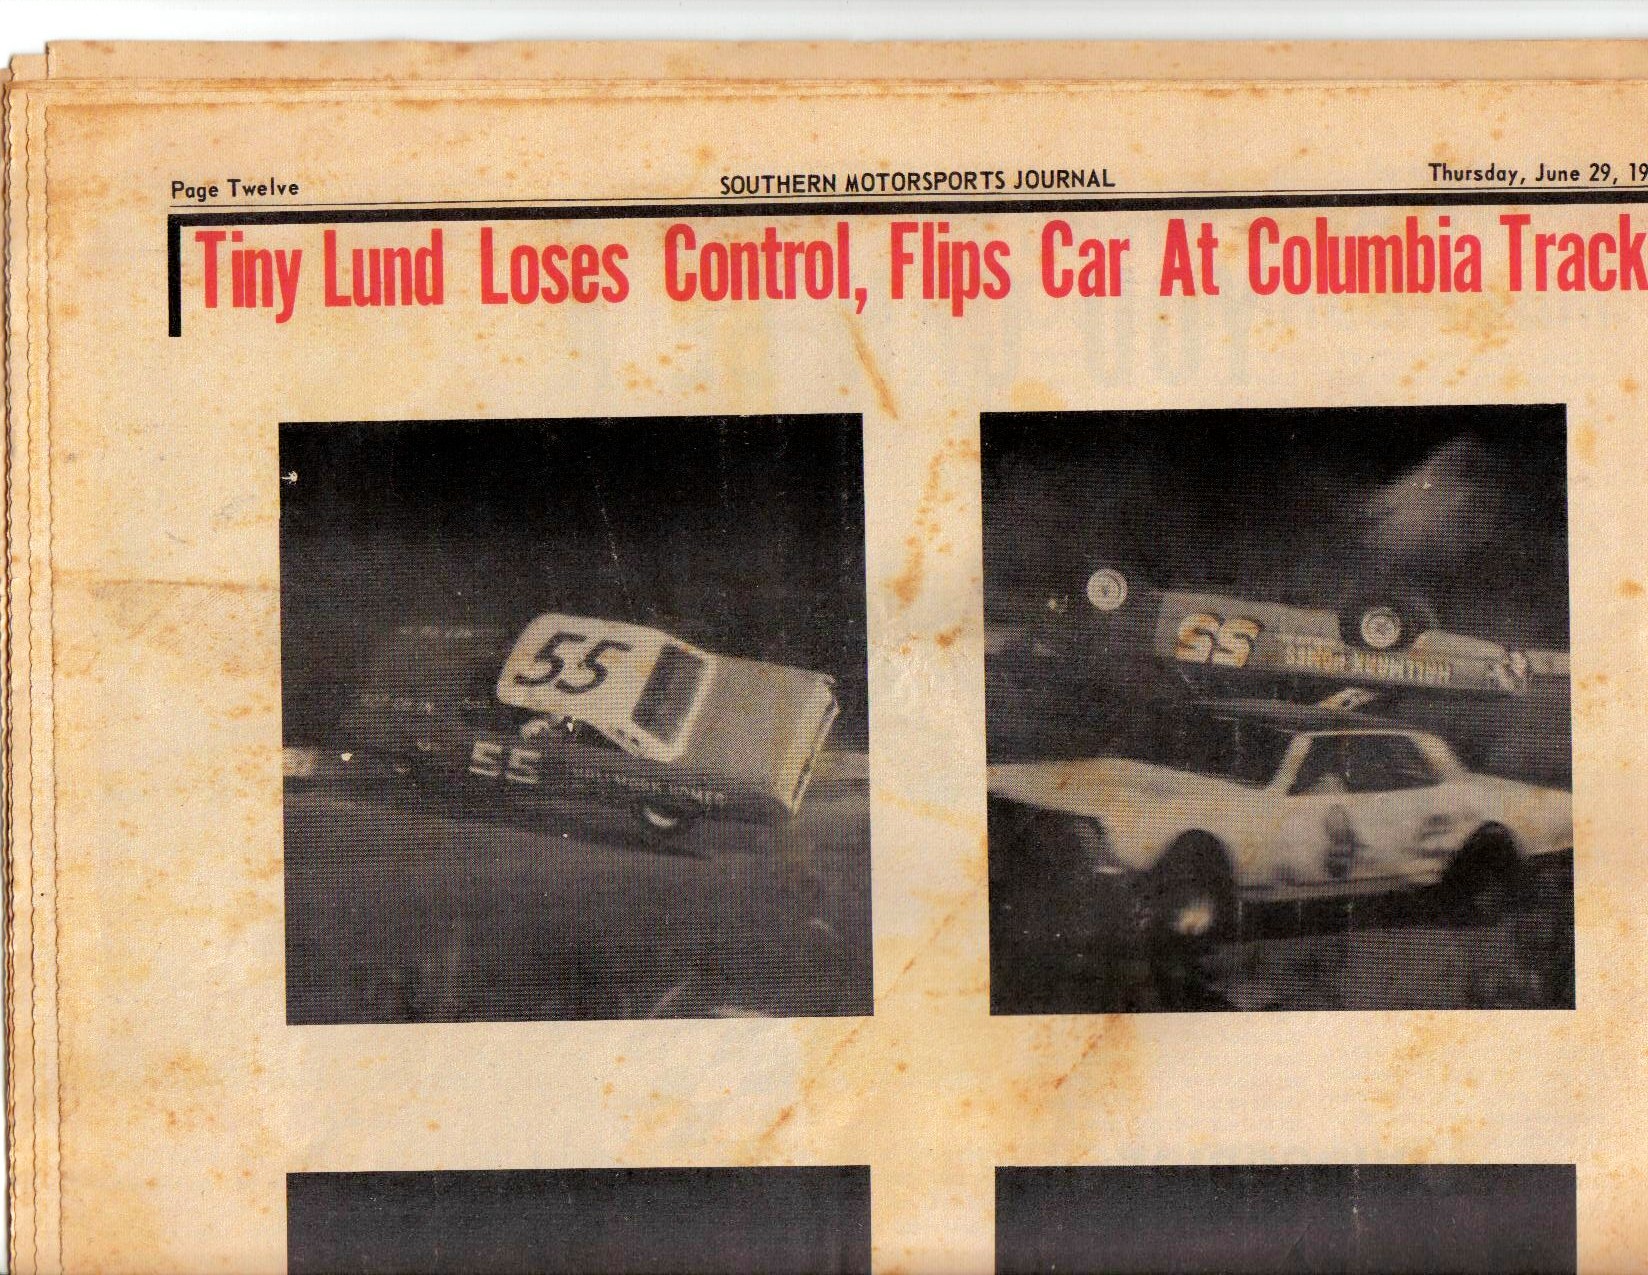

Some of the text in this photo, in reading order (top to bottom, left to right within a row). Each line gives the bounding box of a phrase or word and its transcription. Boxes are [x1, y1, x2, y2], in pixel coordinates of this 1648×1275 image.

[171, 177, 299, 201] Page Twelve
[720, 168, 1116, 195] SOUTHERN MOTORSPORTS JOURNAL
[1428, 162, 1526, 185] Thursday,
[1535, 163, 1580, 182] June
[1589, 162, 1618, 184] 29,
[195, 213, 1648, 324] Tiny Lund Loses Control, Flips Car At Columbia Track
[513, 630, 633, 694] 55
[1175, 612, 1264, 668] 55
[468, 740, 542, 785] 55
